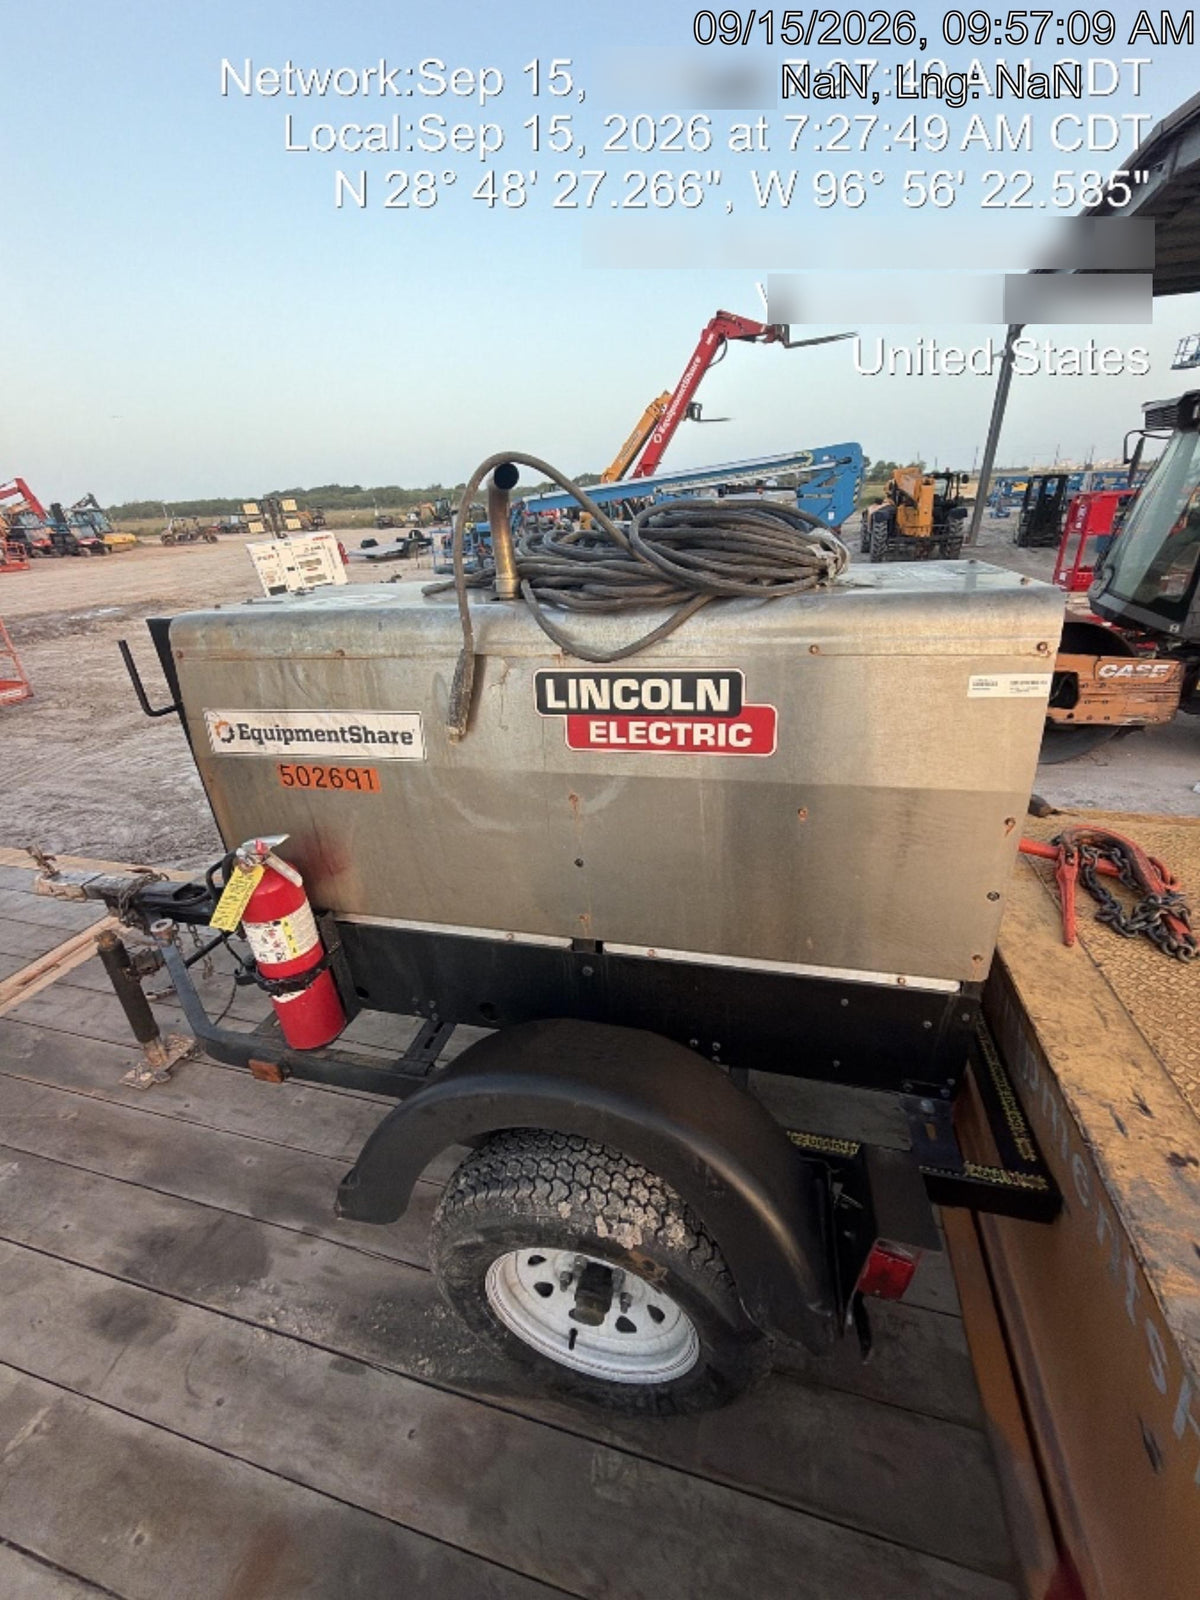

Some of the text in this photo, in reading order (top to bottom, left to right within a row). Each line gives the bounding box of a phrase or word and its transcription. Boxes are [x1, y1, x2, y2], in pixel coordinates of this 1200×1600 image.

[1098, 664, 1171, 678] CASE
[545, 678, 730, 712] LINCOLN
[236, 722, 414, 746] EquipmentShare
[588, 721, 753, 748] ELECTRIC
[279, 764, 374, 790] 502691
